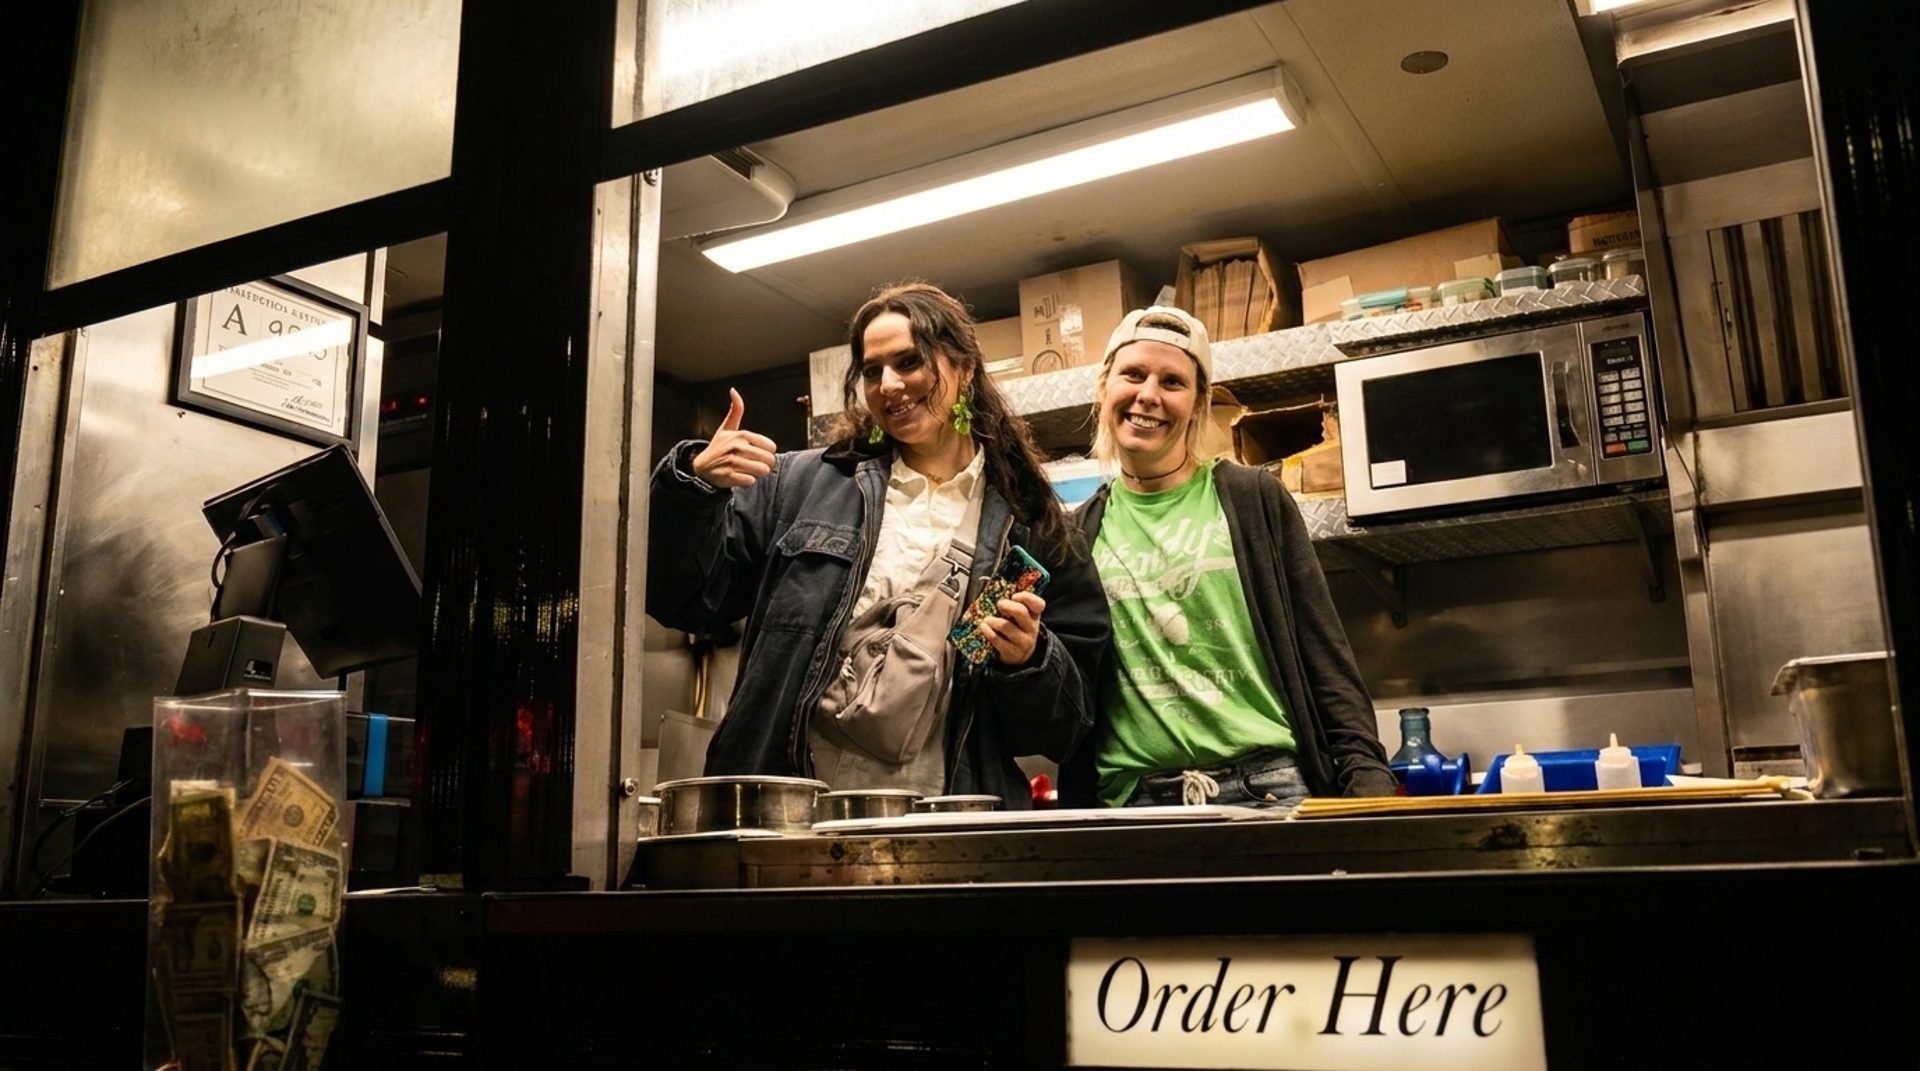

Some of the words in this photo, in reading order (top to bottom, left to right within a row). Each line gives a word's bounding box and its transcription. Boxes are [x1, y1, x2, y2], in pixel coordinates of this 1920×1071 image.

[221, 303, 248, 337] A
[1097, 956, 1296, 1034] Order
[1316, 955, 1508, 1038] Here
